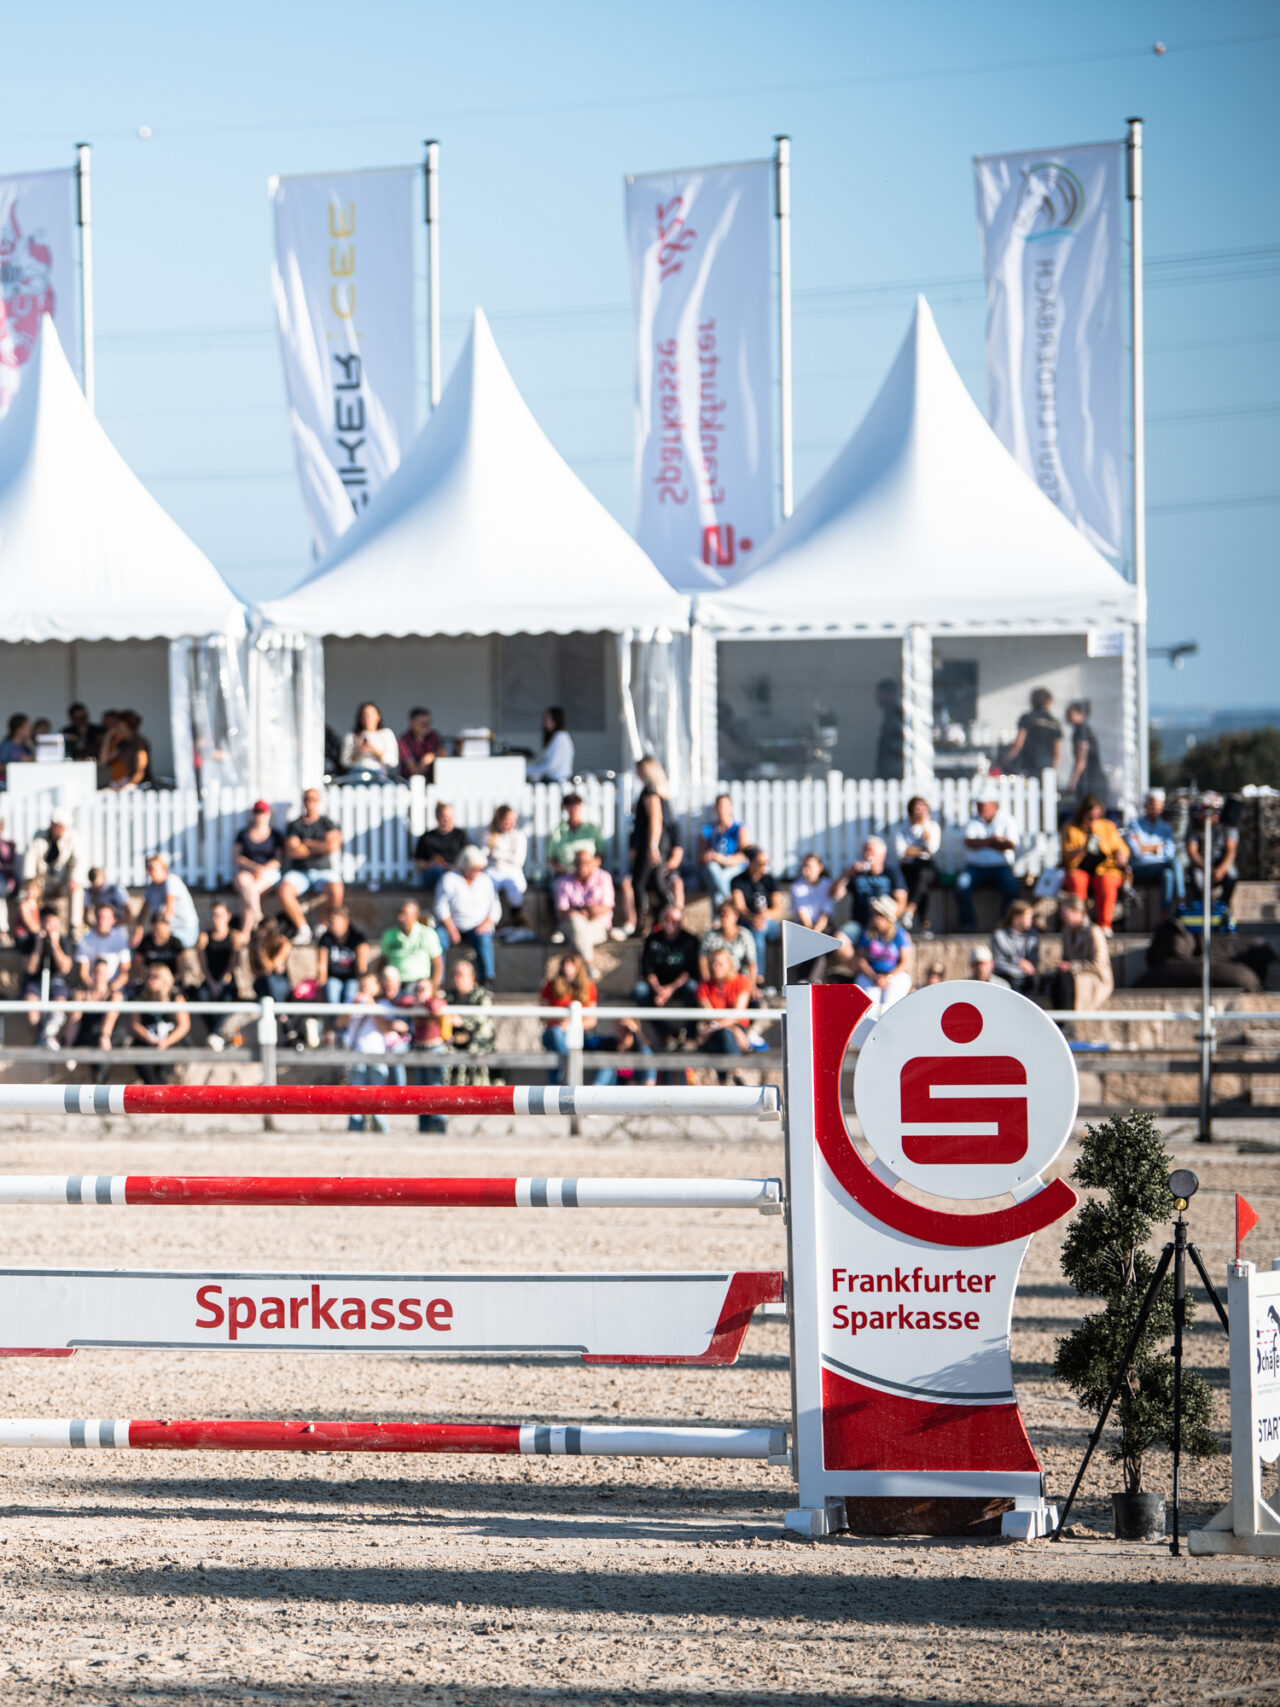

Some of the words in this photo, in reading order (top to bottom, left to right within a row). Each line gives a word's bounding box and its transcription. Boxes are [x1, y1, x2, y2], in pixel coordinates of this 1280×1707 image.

[832, 1267, 997, 1293] Frankfurter
[195, 1284, 454, 1341] Sparkasse
[832, 1303, 980, 1336] Sparkasse
